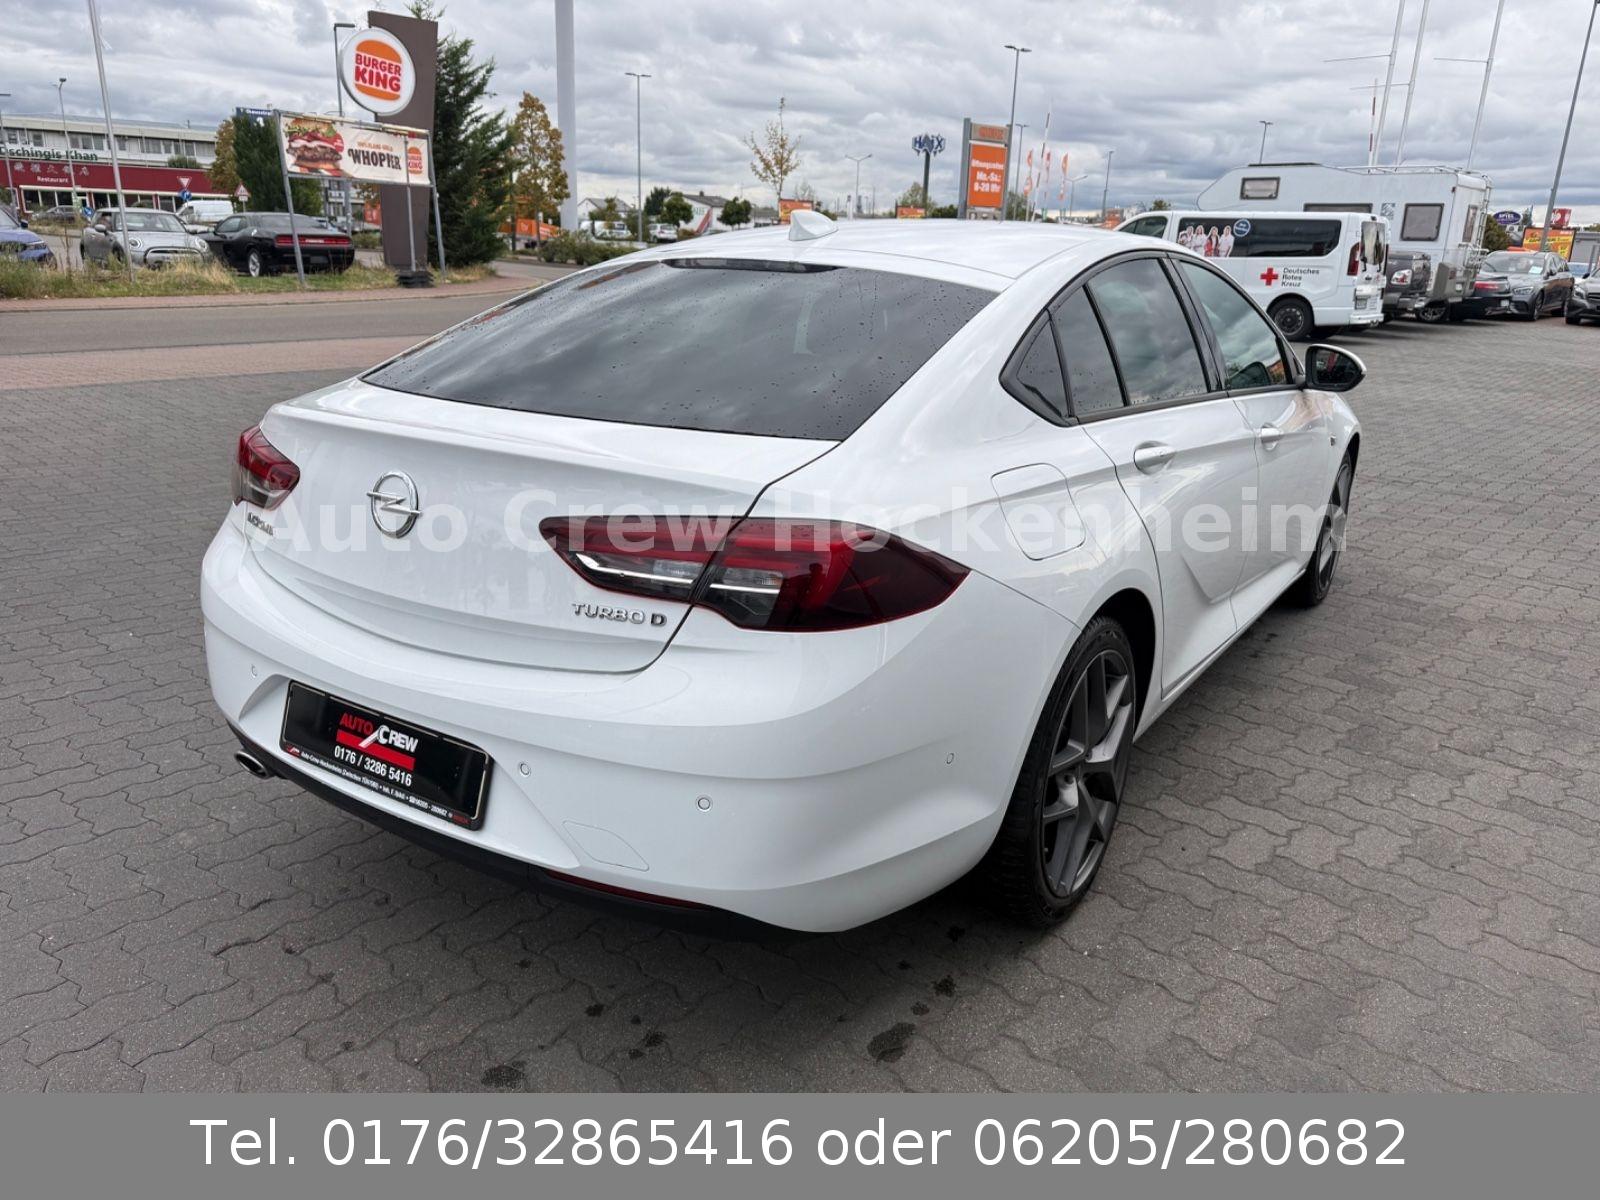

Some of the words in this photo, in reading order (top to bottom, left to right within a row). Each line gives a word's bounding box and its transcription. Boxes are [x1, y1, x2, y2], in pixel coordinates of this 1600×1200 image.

[355, 53, 402, 77] BURGER
[355, 66, 401, 92] KING
[65, 150, 98, 161] Khan
[37, 176, 68, 184] Restaurant
[1283, 267, 1320, 275] Deutsches
[571, 602, 646, 625] TURBO
[650, 612, 668, 627] D
[339, 713, 373, 735] AUTO
[377, 724, 419, 753] CREW
[334, 745, 356, 765] 0176
[364, 757, 387, 776] 3286
[388, 769, 413, 787] 5416
